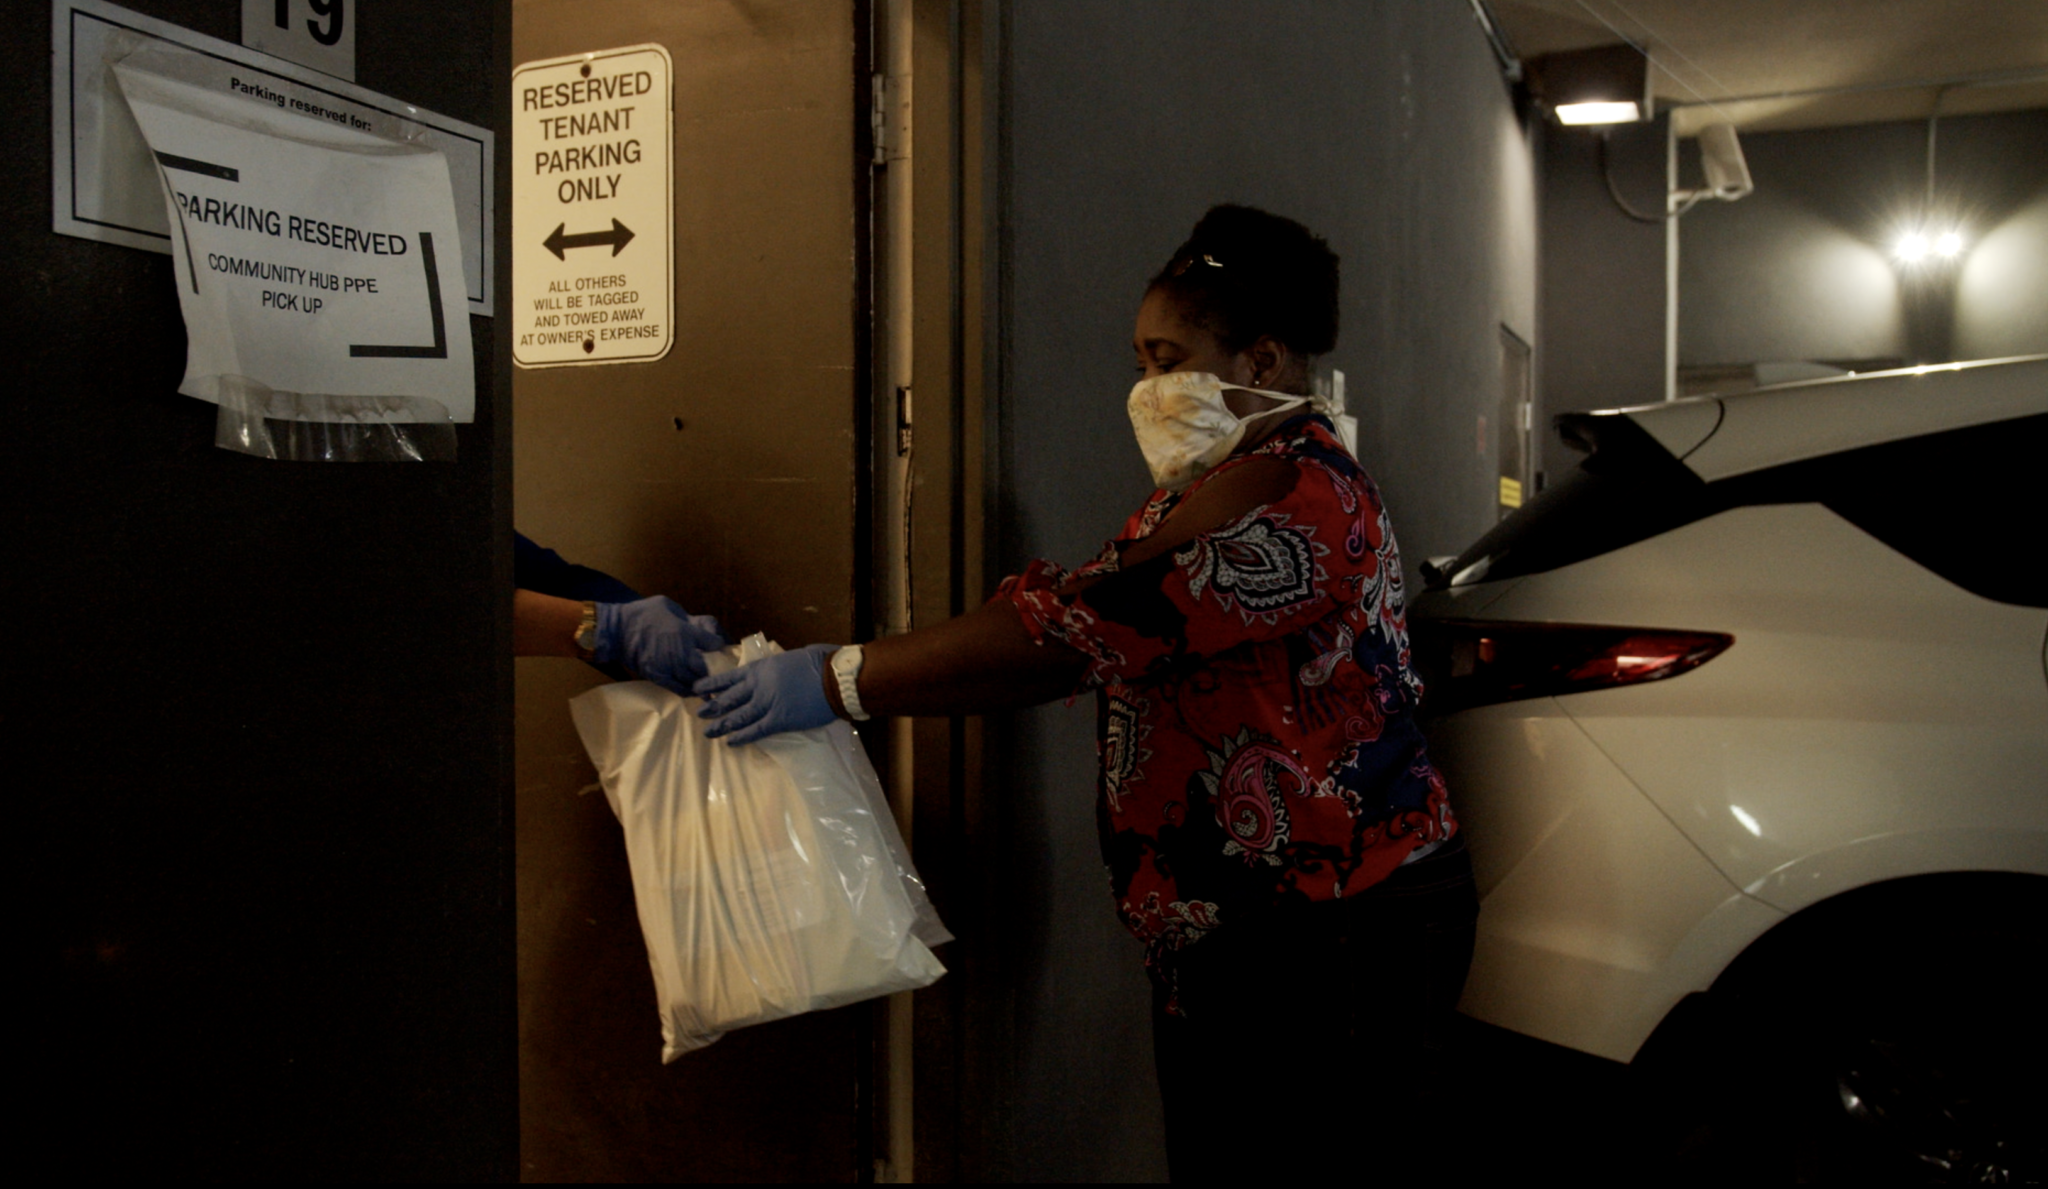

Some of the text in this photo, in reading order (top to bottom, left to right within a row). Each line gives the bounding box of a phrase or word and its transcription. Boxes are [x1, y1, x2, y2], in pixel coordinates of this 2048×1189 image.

[231, 77, 372, 132] Parking reserved for:
[523, 71, 652, 111] RESERVED
[539, 106, 635, 141] TENANT
[535, 139, 642, 175] PARKING
[558, 174, 622, 204] ONLY
[176, 191, 407, 256] PARKING RESERVED
[208, 252, 379, 294] COMMUNITY HUB PPE
[548, 274, 627, 293] ALL OTHERS
[262, 290, 323, 315] PICK UP
[534, 291, 640, 311] WILL BE TAGGED
[534, 308, 646, 328] AND TOWED AWAY
[520, 325, 660, 346] AT OWNER'S EXPENSE
